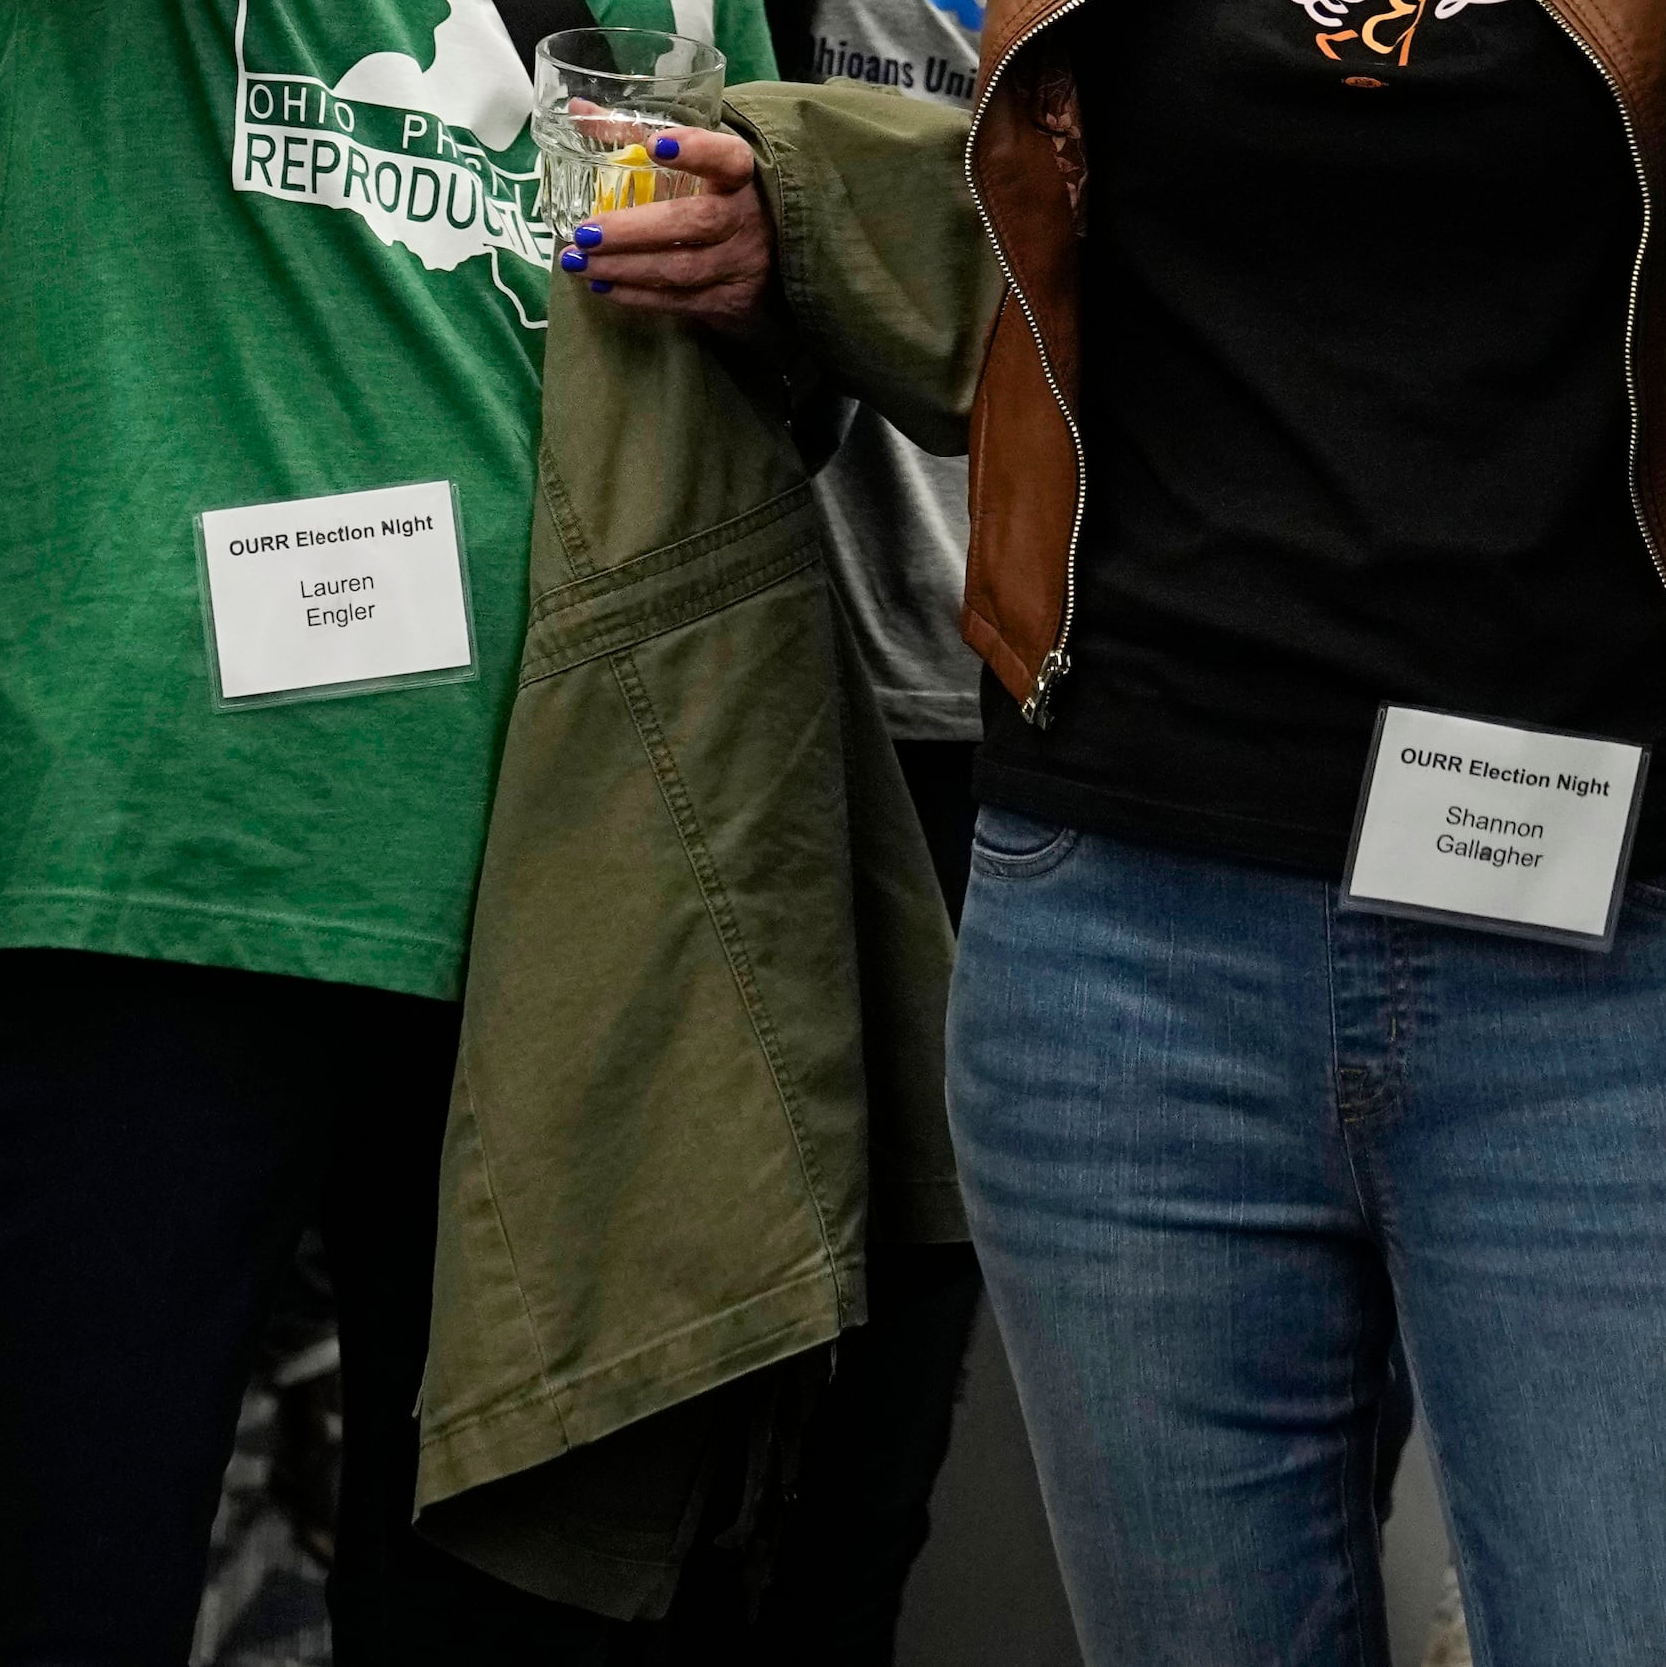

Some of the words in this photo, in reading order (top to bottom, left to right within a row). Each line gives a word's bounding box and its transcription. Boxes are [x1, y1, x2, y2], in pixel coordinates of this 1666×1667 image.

[248, 84, 355, 133] OHIO
[229, 533, 290, 557] OURR
[295, 523, 375, 548] Election
[380, 515, 434, 538] Night
[300, 575, 375, 599] Lauren
[306, 602, 376, 628] Engler
[1400, 747, 1463, 774] OURR
[1468, 760, 1551, 789] Election
[1556, 774, 1610, 798] Night
[1445, 805, 1544, 839] Shannon
[1435, 834, 1544, 869] Gallagher
